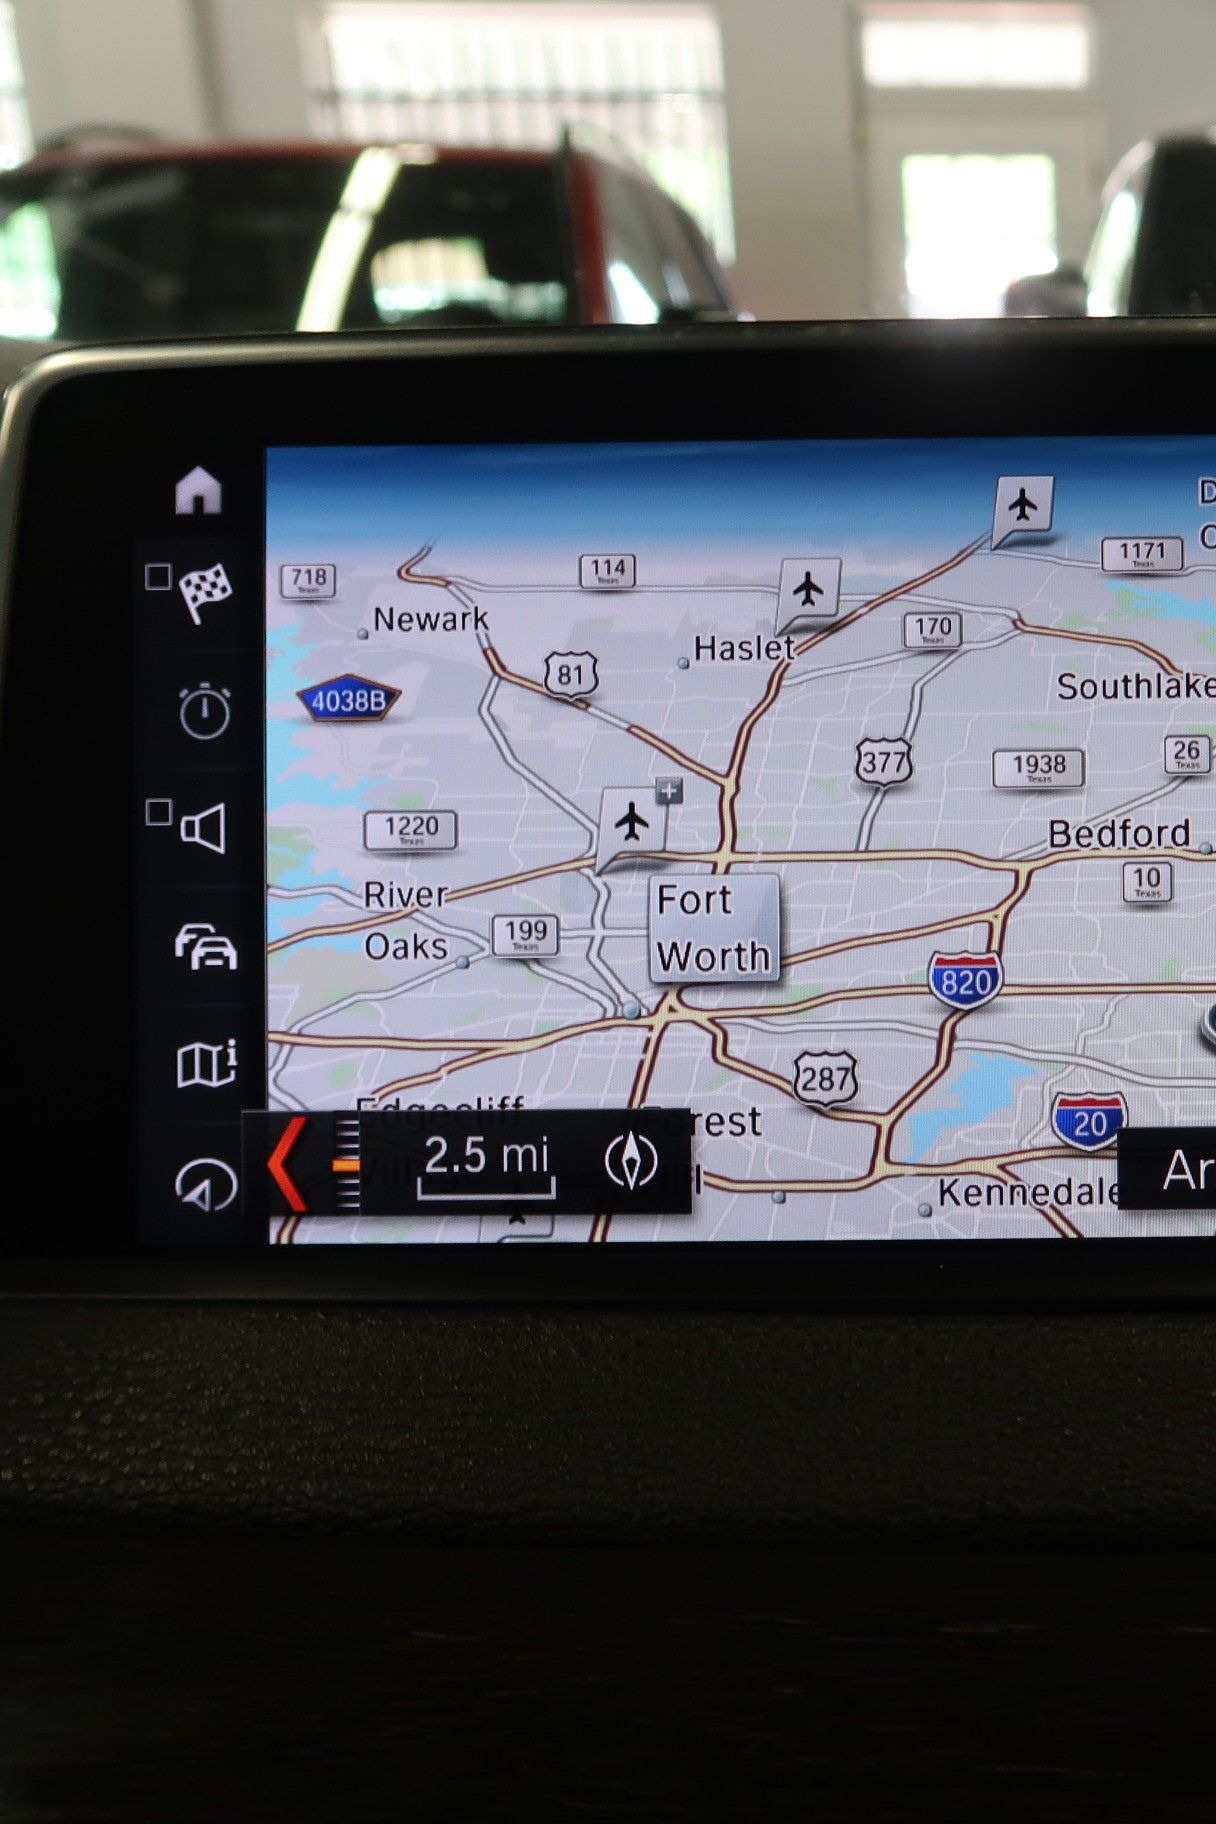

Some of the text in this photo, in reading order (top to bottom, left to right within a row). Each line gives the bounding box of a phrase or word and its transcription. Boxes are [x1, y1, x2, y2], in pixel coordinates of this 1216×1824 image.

[1118, 542, 1166, 559] 1171
[291, 569, 327, 586] 718
[590, 560, 626, 577] 114
[374, 606, 490, 633] Newark
[914, 618, 952, 636] 170
[695, 636, 796, 662] Haslet
[557, 665, 584, 686] 81
[312, 690, 387, 712] 4038B
[863, 751, 906, 774] 377
[1174, 741, 1201, 761] 26
[1012, 755, 1067, 774] 1938
[385, 817, 440, 837] 1220
[1050, 819, 1190, 848] Bedford
[1133, 868, 1162, 888] 10
[365, 881, 449, 908] River
[658, 885, 732, 916] Fort
[505, 920, 548, 940] 199
[365, 932, 448, 960] Oaks
[658, 940, 770, 972] Worth
[941, 971, 992, 996] 820
[801, 1066, 851, 1092] 287
[1073, 1111, 1108, 1137] 20
[425, 1135, 486, 1173] 2.5
[503, 1135, 549, 1173] mi
[939, 1178, 1120, 1208] Kennedale
